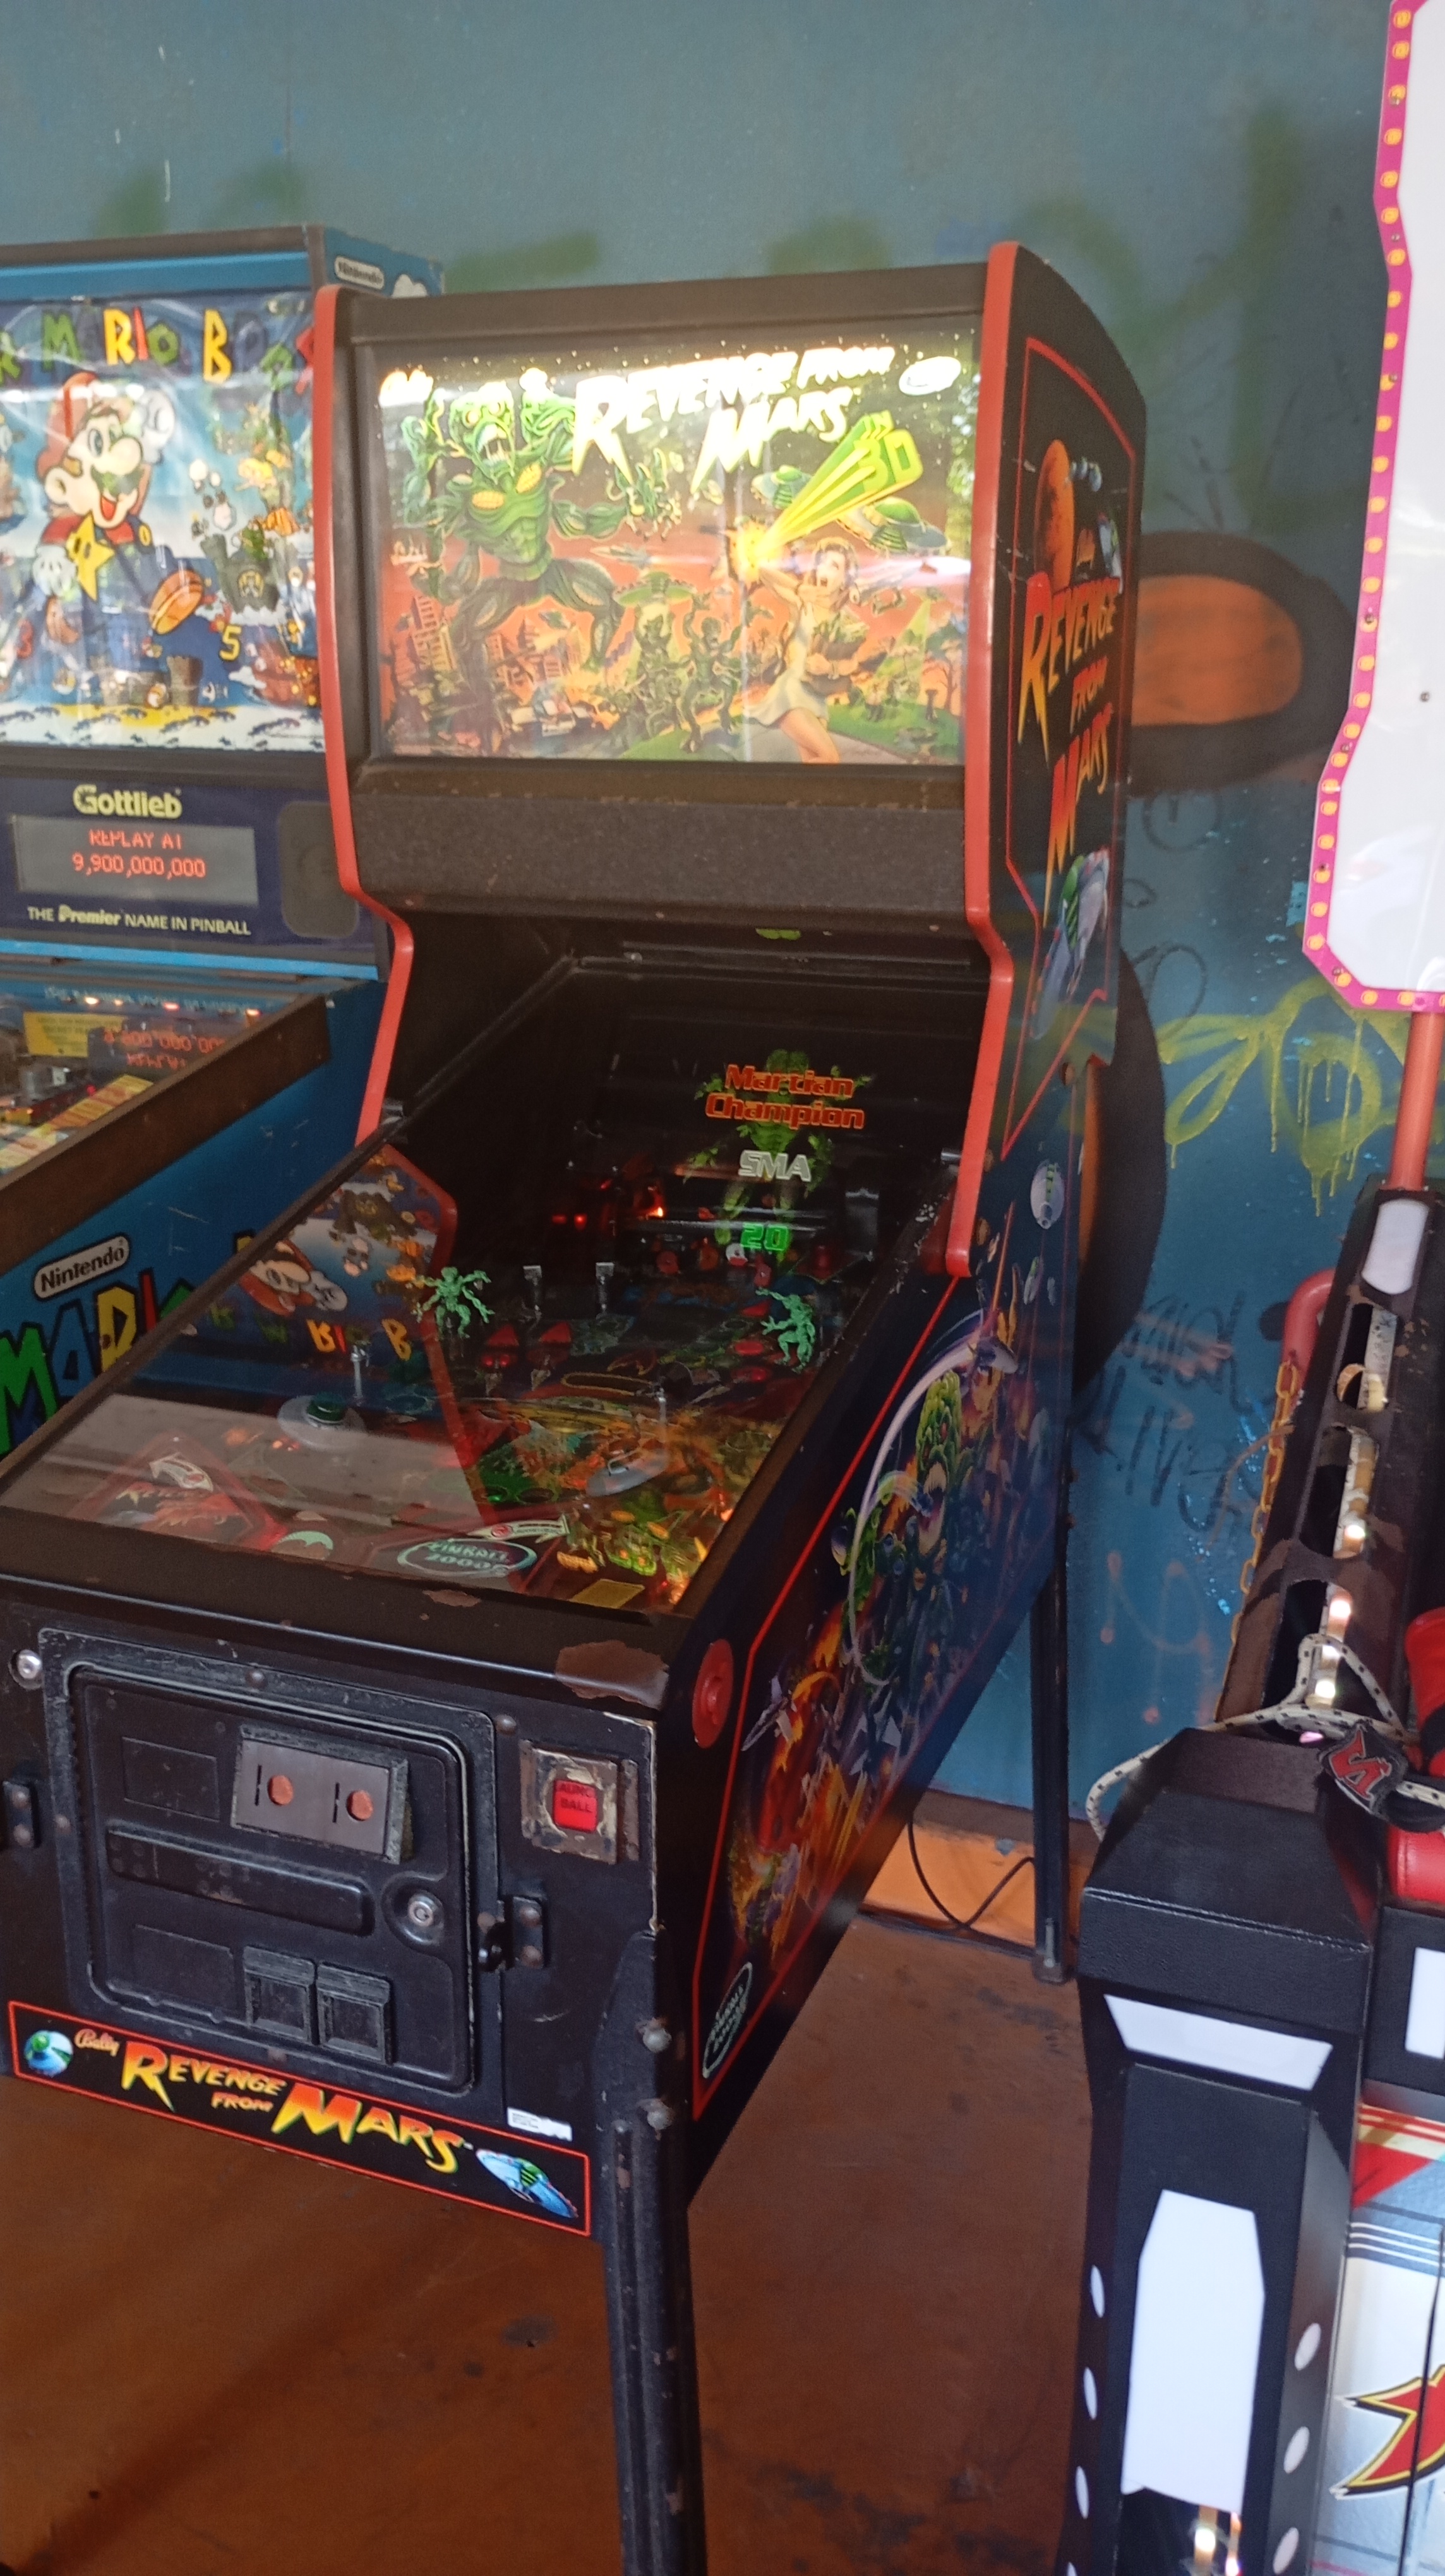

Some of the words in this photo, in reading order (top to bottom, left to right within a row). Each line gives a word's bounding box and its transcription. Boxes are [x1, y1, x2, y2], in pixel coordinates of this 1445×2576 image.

[690, 385, 854, 496] MARS
[855, 428, 925, 494] 3D
[1018, 571, 1120, 766] REVENGE
[72, 784, 183, 819] Gottlieb
[27, 905, 55, 922] THE
[58, 903, 123, 926] Premier
[124, 913, 169, 930] NAME
[171, 916, 188, 931] IN
[190, 917, 252, 936] PINBALL
[724, 1064, 854, 1099] Martian
[705, 1092, 866, 1130] Champion
[738, 1149, 812, 1183] SMA
[740, 1222, 790, 1252] 20
[40, 1245, 126, 1292] Nintendo
[74, 2028, 120, 2057] Bally
[121, 2041, 289, 2113] REVENGE
[211, 2090, 274, 2113] FROM
[270, 2082, 465, 2174] MARS
